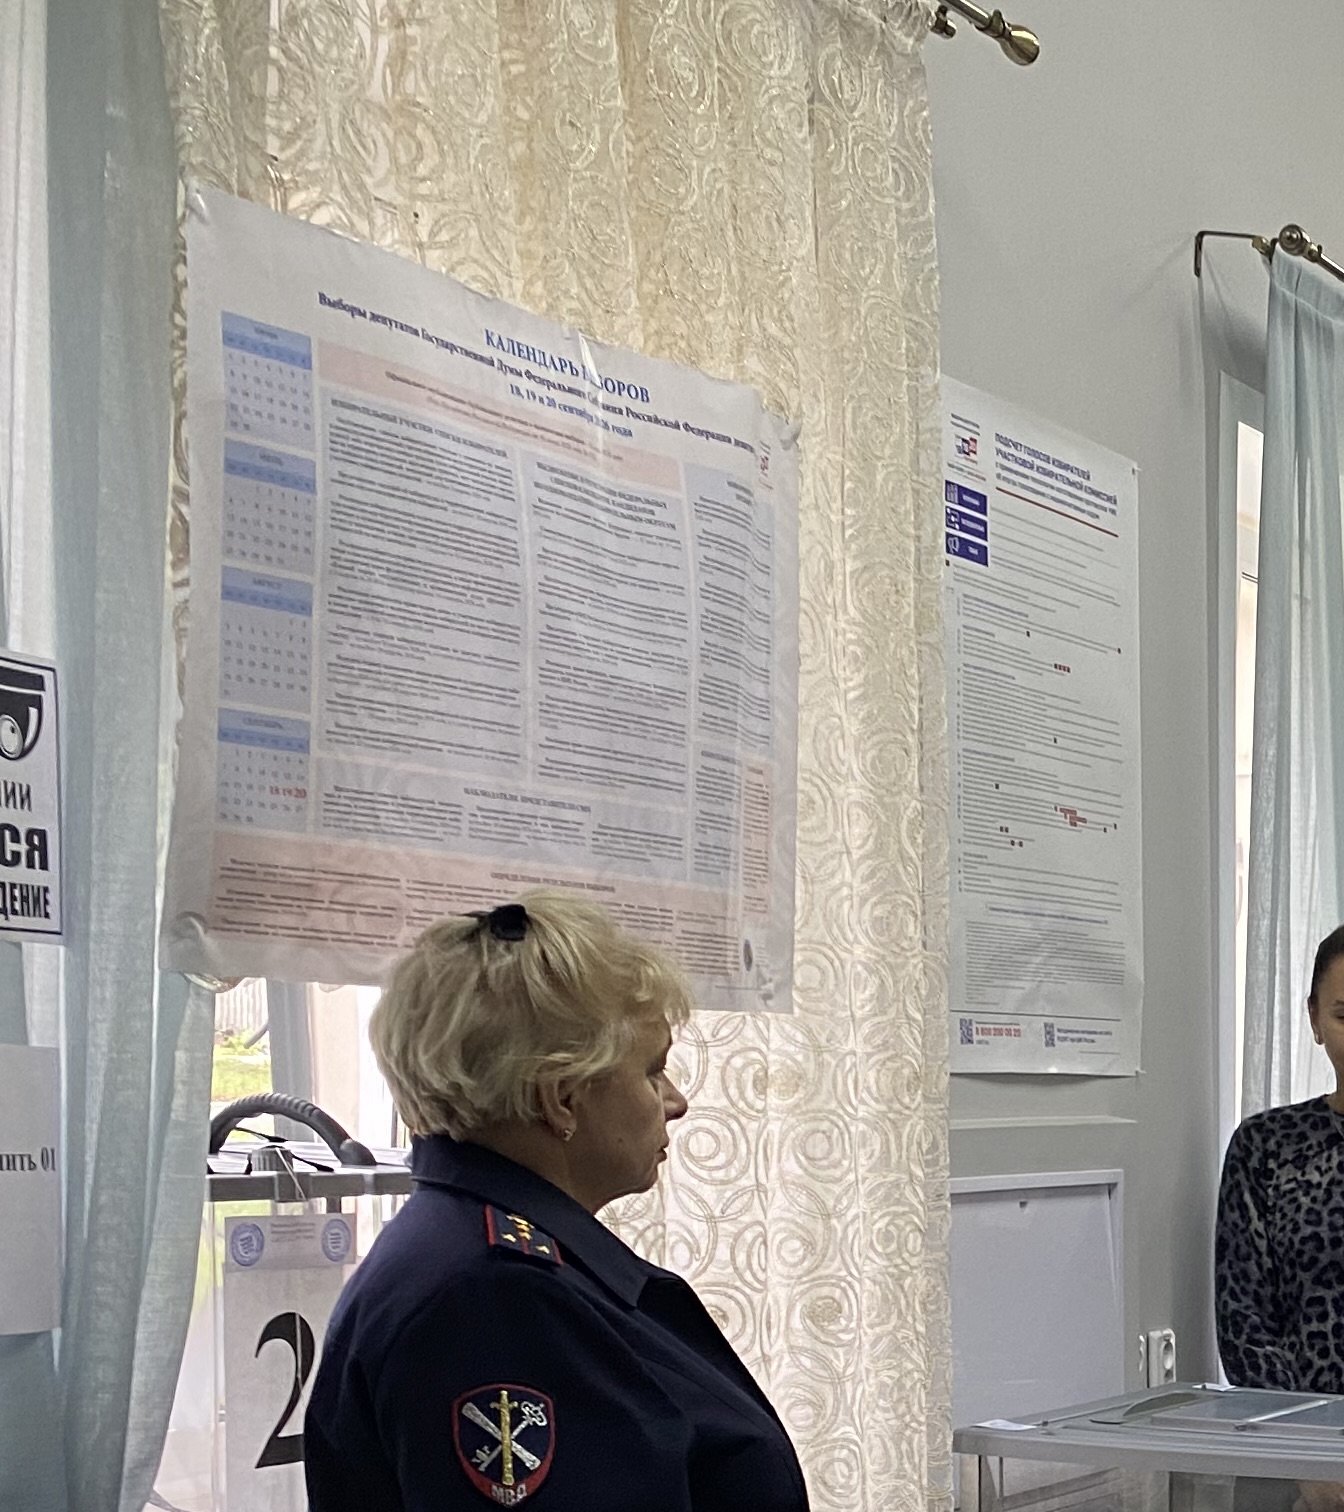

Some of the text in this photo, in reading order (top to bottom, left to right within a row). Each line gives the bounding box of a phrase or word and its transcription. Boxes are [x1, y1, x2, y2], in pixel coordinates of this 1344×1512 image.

[318, 291, 367, 319] Выборы
[484, 328, 650, 403] КАЛЕНДАРЬ ОРОВ
[0, 780, 32, 812] ИИ
[41, 1147, 56, 1172] 01
[255, 1312, 315, 1469] 2
